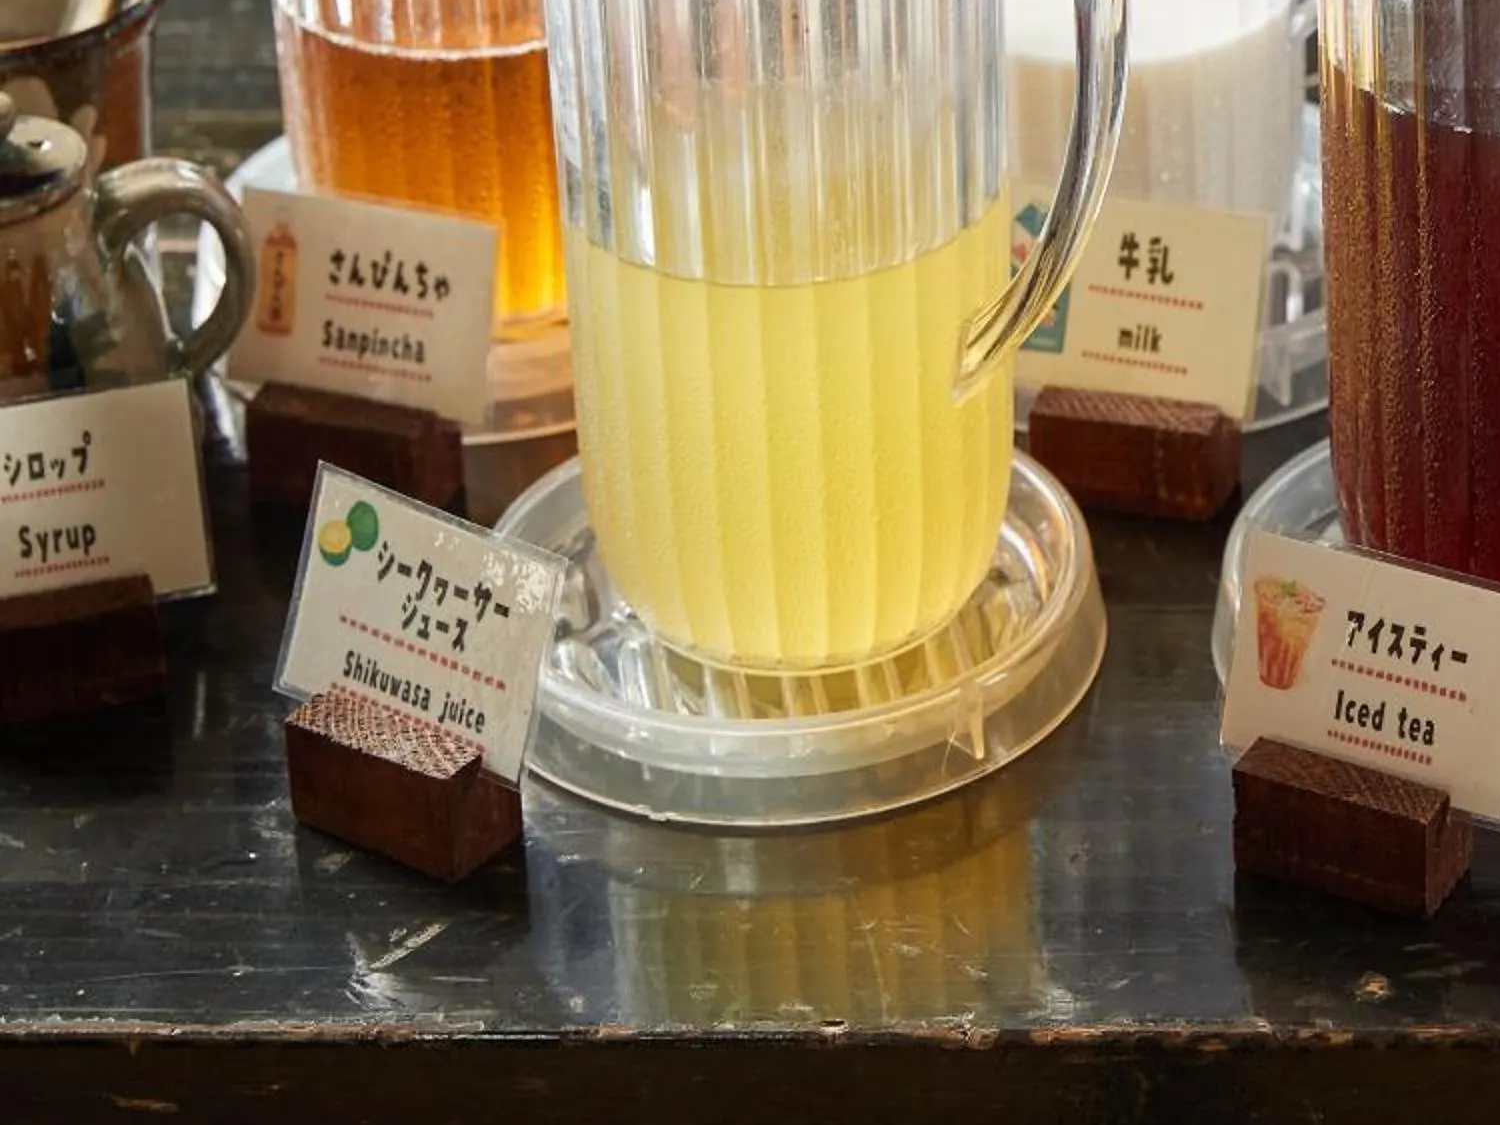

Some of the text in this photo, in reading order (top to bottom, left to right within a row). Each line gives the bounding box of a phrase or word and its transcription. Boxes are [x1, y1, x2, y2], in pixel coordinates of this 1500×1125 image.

[1118, 232, 1174, 285] 牛乳
[321, 320, 426, 364] Sanpincha
[1118, 325, 1163, 354] milk
[4, 430, 91, 487] シロップ
[18, 524, 96, 563] Syrup
[1347, 610, 1469, 672] アイスティー
[342, 650, 486, 735] Shikuwasa juice
[1334, 689, 1435, 746] Iced tea
